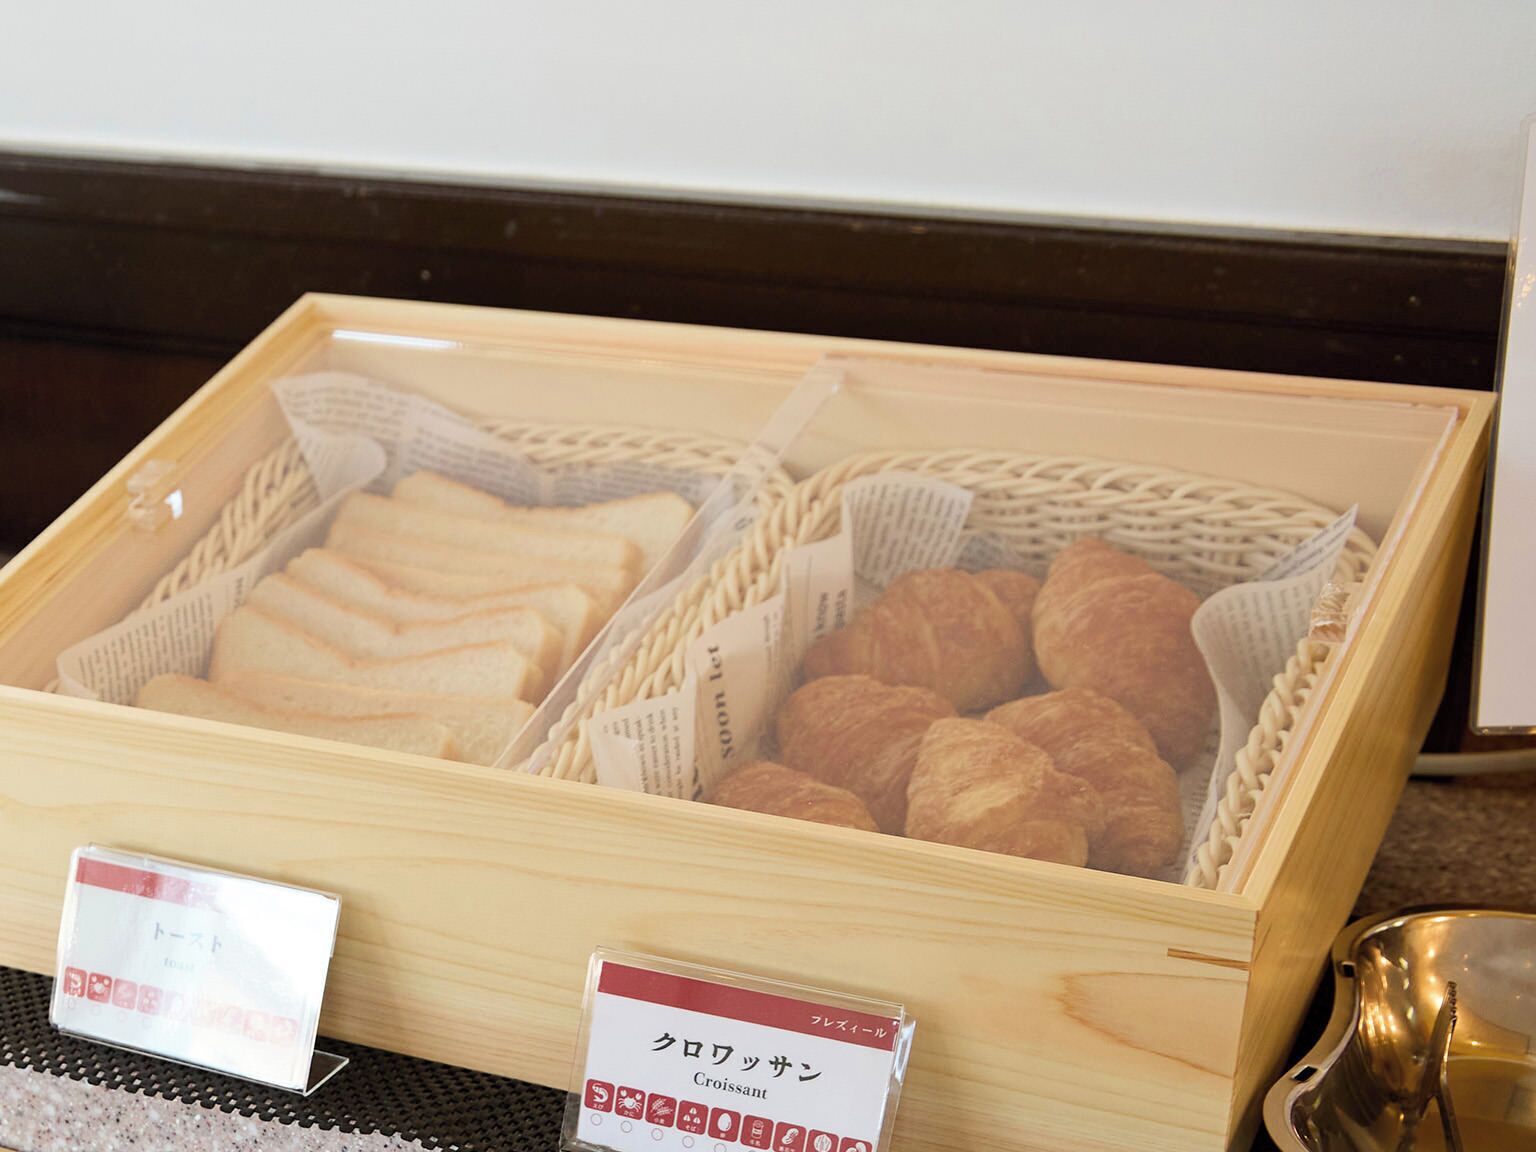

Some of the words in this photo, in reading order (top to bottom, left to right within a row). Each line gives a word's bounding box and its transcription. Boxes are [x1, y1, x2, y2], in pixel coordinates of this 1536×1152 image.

[707, 642, 722, 683] let
[716, 689, 733, 760] soon
[651, 1031, 822, 1084] クロワッサン
[693, 1070, 769, 1101] Croissant
